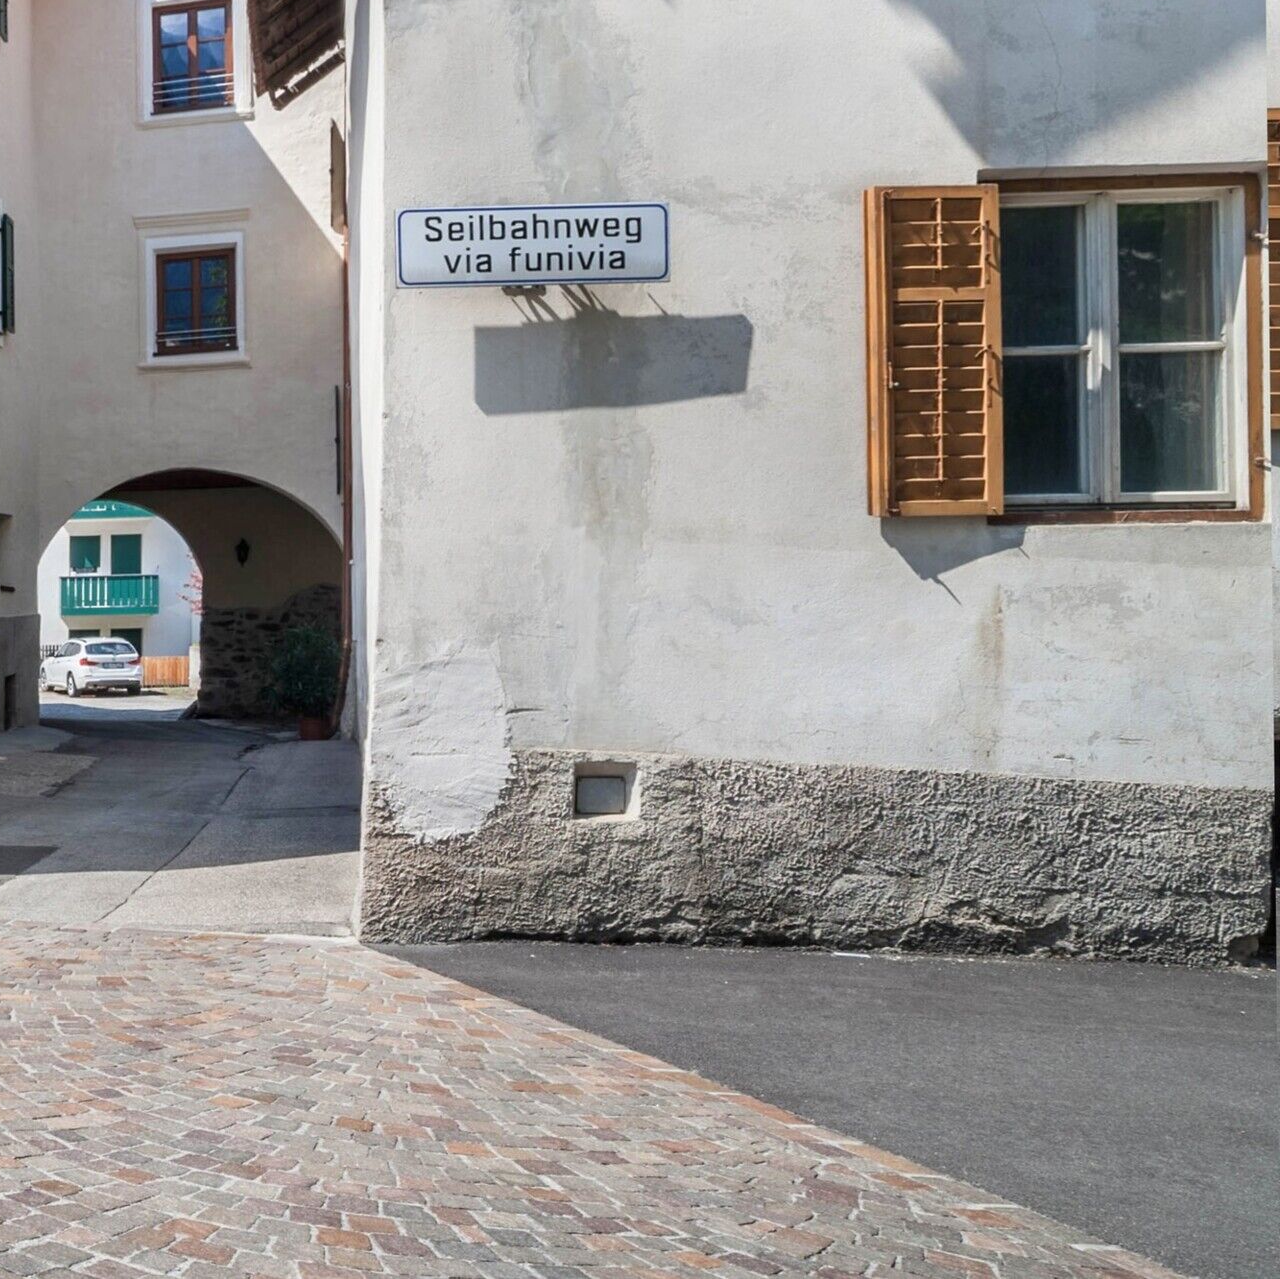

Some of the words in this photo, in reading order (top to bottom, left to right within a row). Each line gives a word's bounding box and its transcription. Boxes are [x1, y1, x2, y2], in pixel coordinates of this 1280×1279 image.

[424, 213, 643, 244] Seilbahnweg
[443, 247, 493, 274] via
[509, 244, 627, 272] funivia
